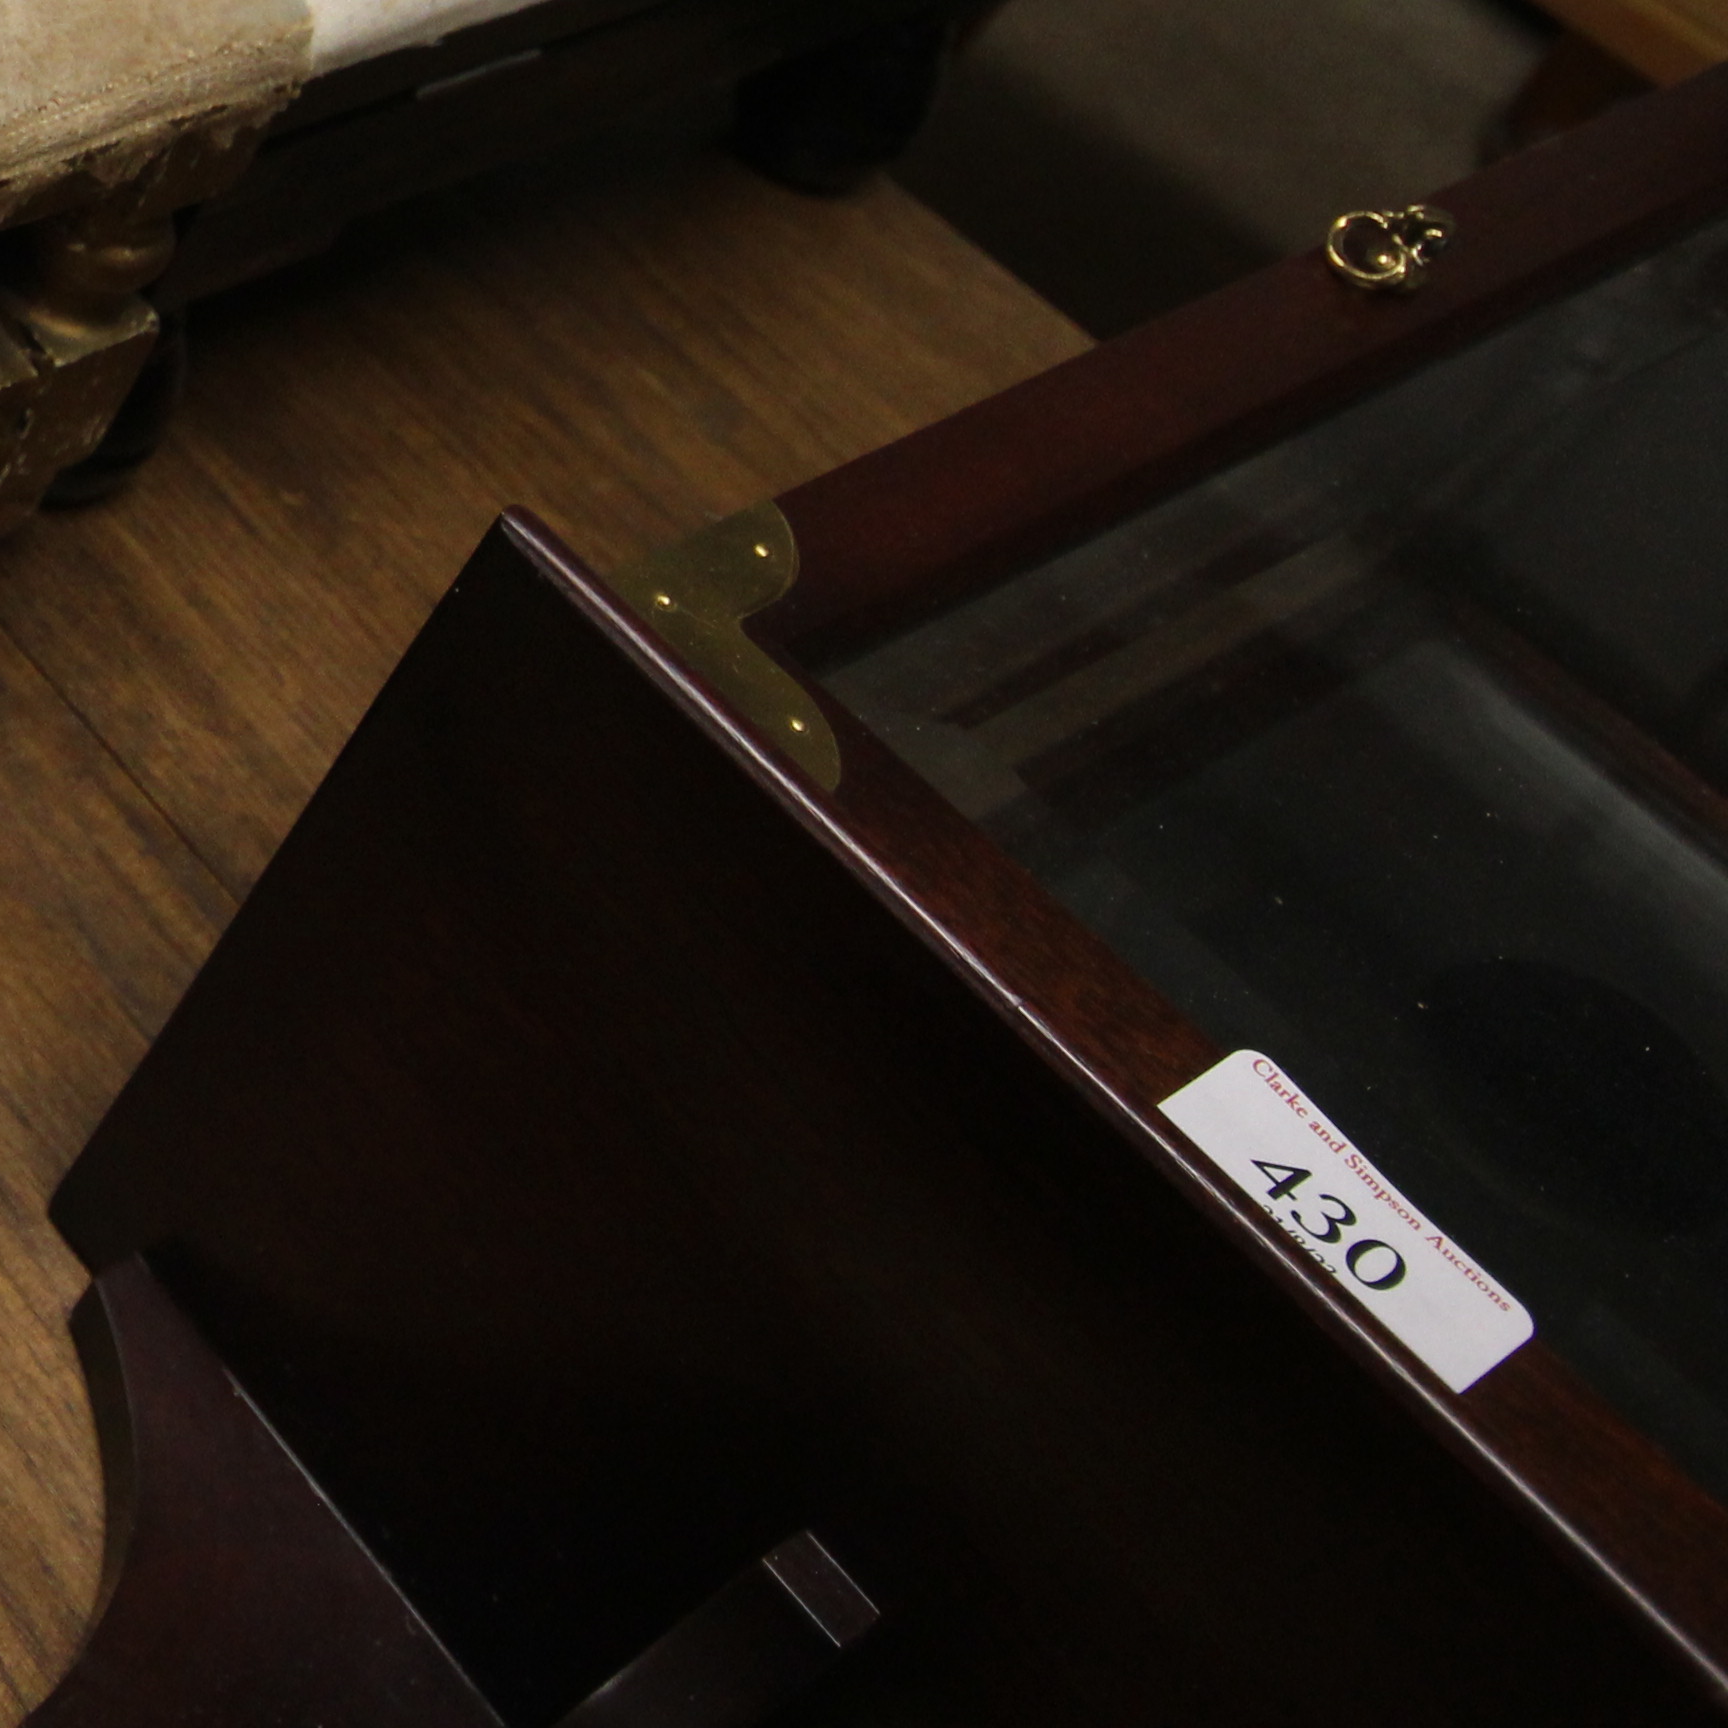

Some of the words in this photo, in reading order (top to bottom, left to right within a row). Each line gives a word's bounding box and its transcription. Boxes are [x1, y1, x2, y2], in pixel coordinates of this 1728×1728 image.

[1251, 1159, 1407, 1290] 430
[1252, 1058, 1309, 1119] Clarke
[1308, 1120, 1348, 1154] and
[1344, 1153, 1423, 1232] Simpson
[1425, 1235, 1514, 1313] Auctions
